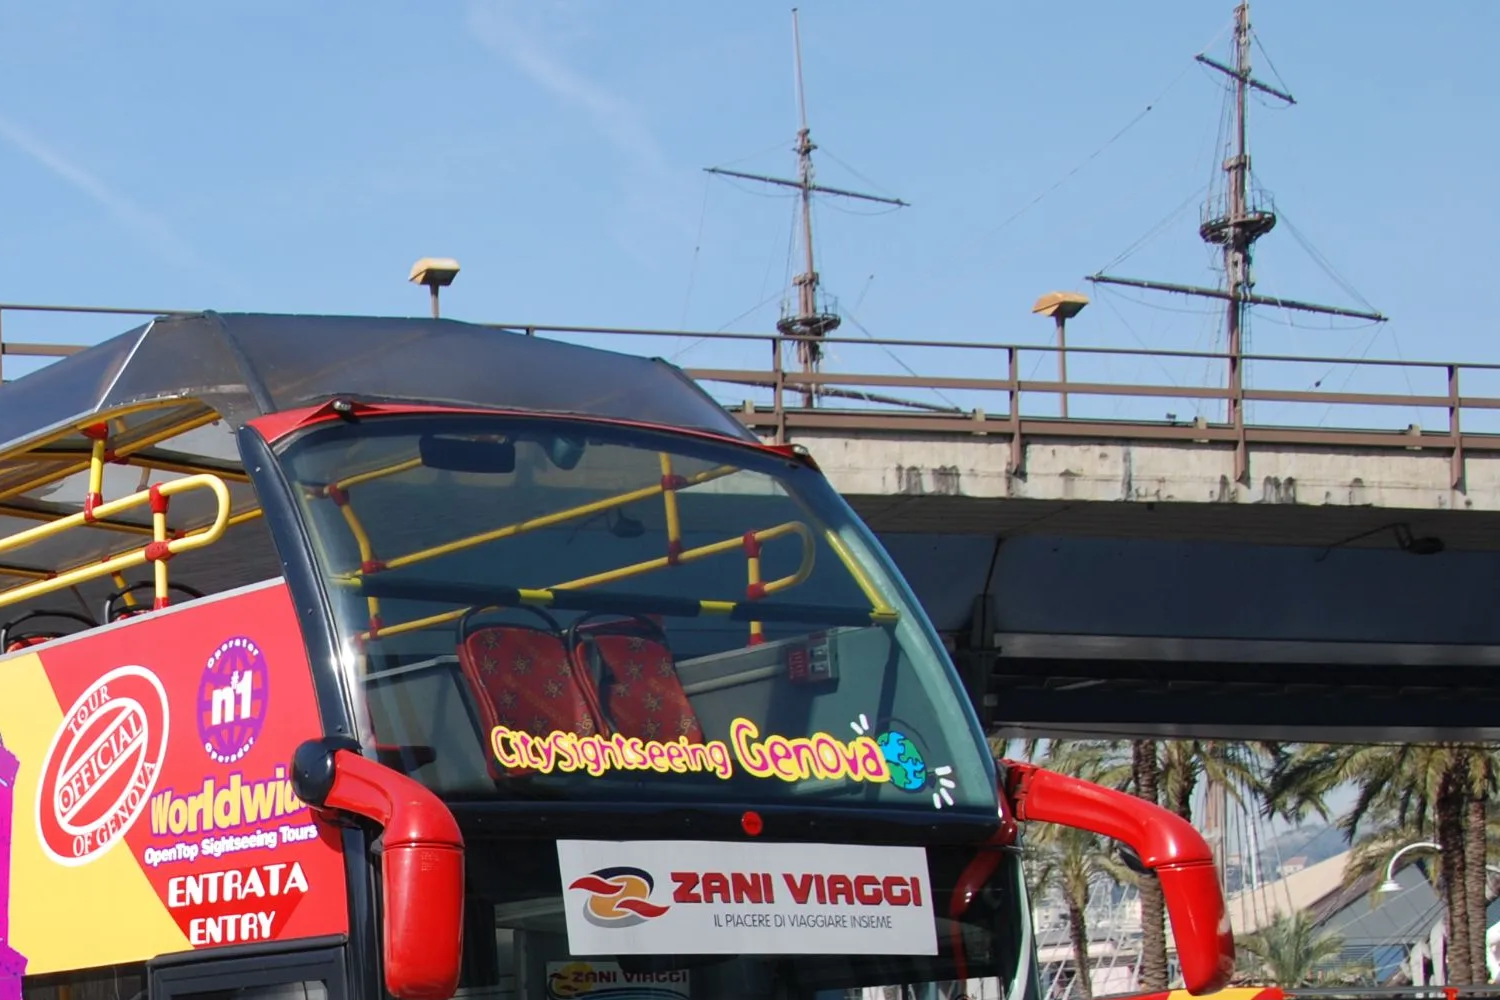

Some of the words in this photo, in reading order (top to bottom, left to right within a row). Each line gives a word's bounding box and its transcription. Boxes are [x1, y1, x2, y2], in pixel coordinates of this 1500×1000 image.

[67, 684, 111, 736] TOUR
[58, 712, 143, 813] OFFICIAL
[491, 725, 732, 780] CitySightseeing
[729, 717, 892, 783] Genova
[72, 831, 94, 857] OF
[95, 761, 157, 846] GENOVA
[151, 766, 309, 835] Worldwid
[144, 841, 199, 868] OpenTop
[201, 829, 278, 857] Sightseeing
[279, 824, 318, 844] Tours
[167, 861, 309, 908] ENTRATA
[670, 871, 775, 904] ZANI
[781, 873, 923, 907] VIAGGI
[189, 910, 276, 946] ENTRY
[713, 914, 723, 928] IL
[725, 914, 771, 928] PIACERE
[774, 914, 786, 928] DI
[787, 914, 848, 928] VIAGGIARE
[850, 915, 893, 929] INSIEME
[571, 971, 617, 983] ZANI
[622, 971, 687, 983] VIAGGI
